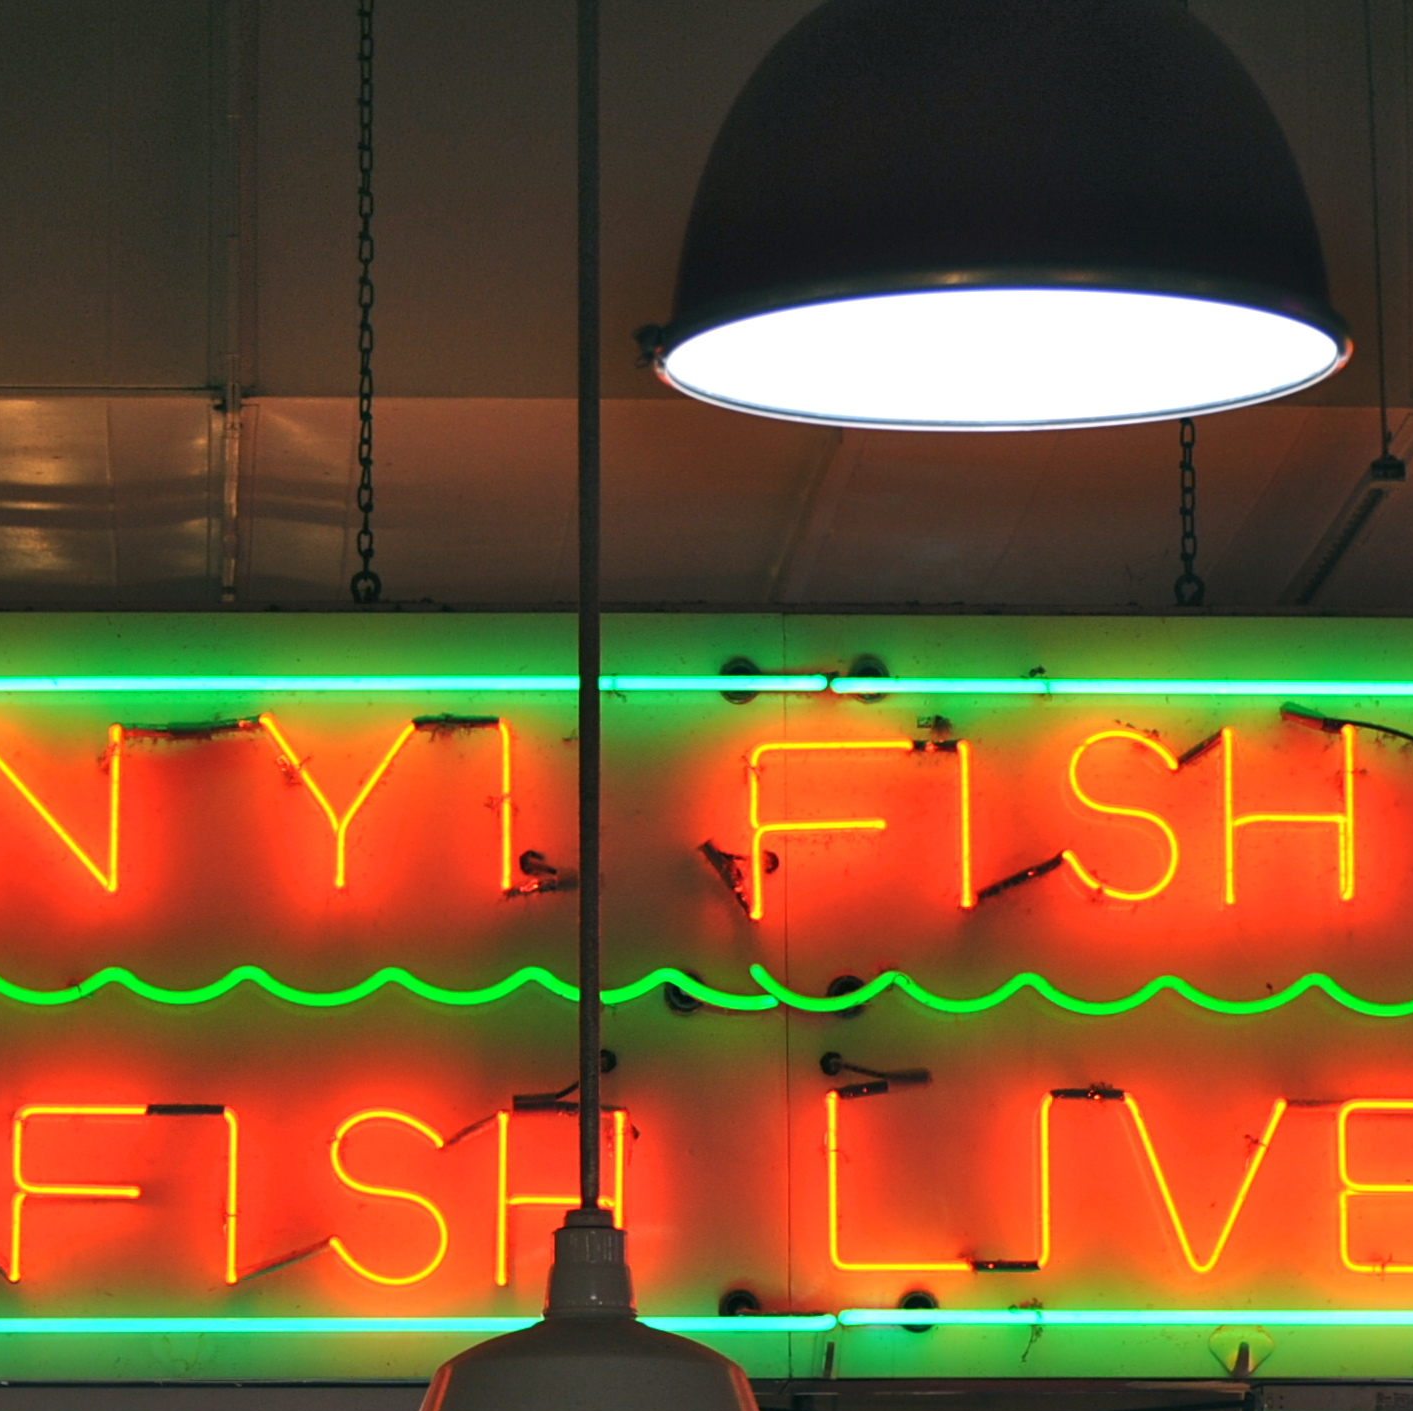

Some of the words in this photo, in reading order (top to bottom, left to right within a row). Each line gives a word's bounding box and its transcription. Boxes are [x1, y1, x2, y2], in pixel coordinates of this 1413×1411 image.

[259, 712, 513, 894] YI
[748, 724, 1356, 921] FISH
[7, 1103, 626, 1287] FISH
